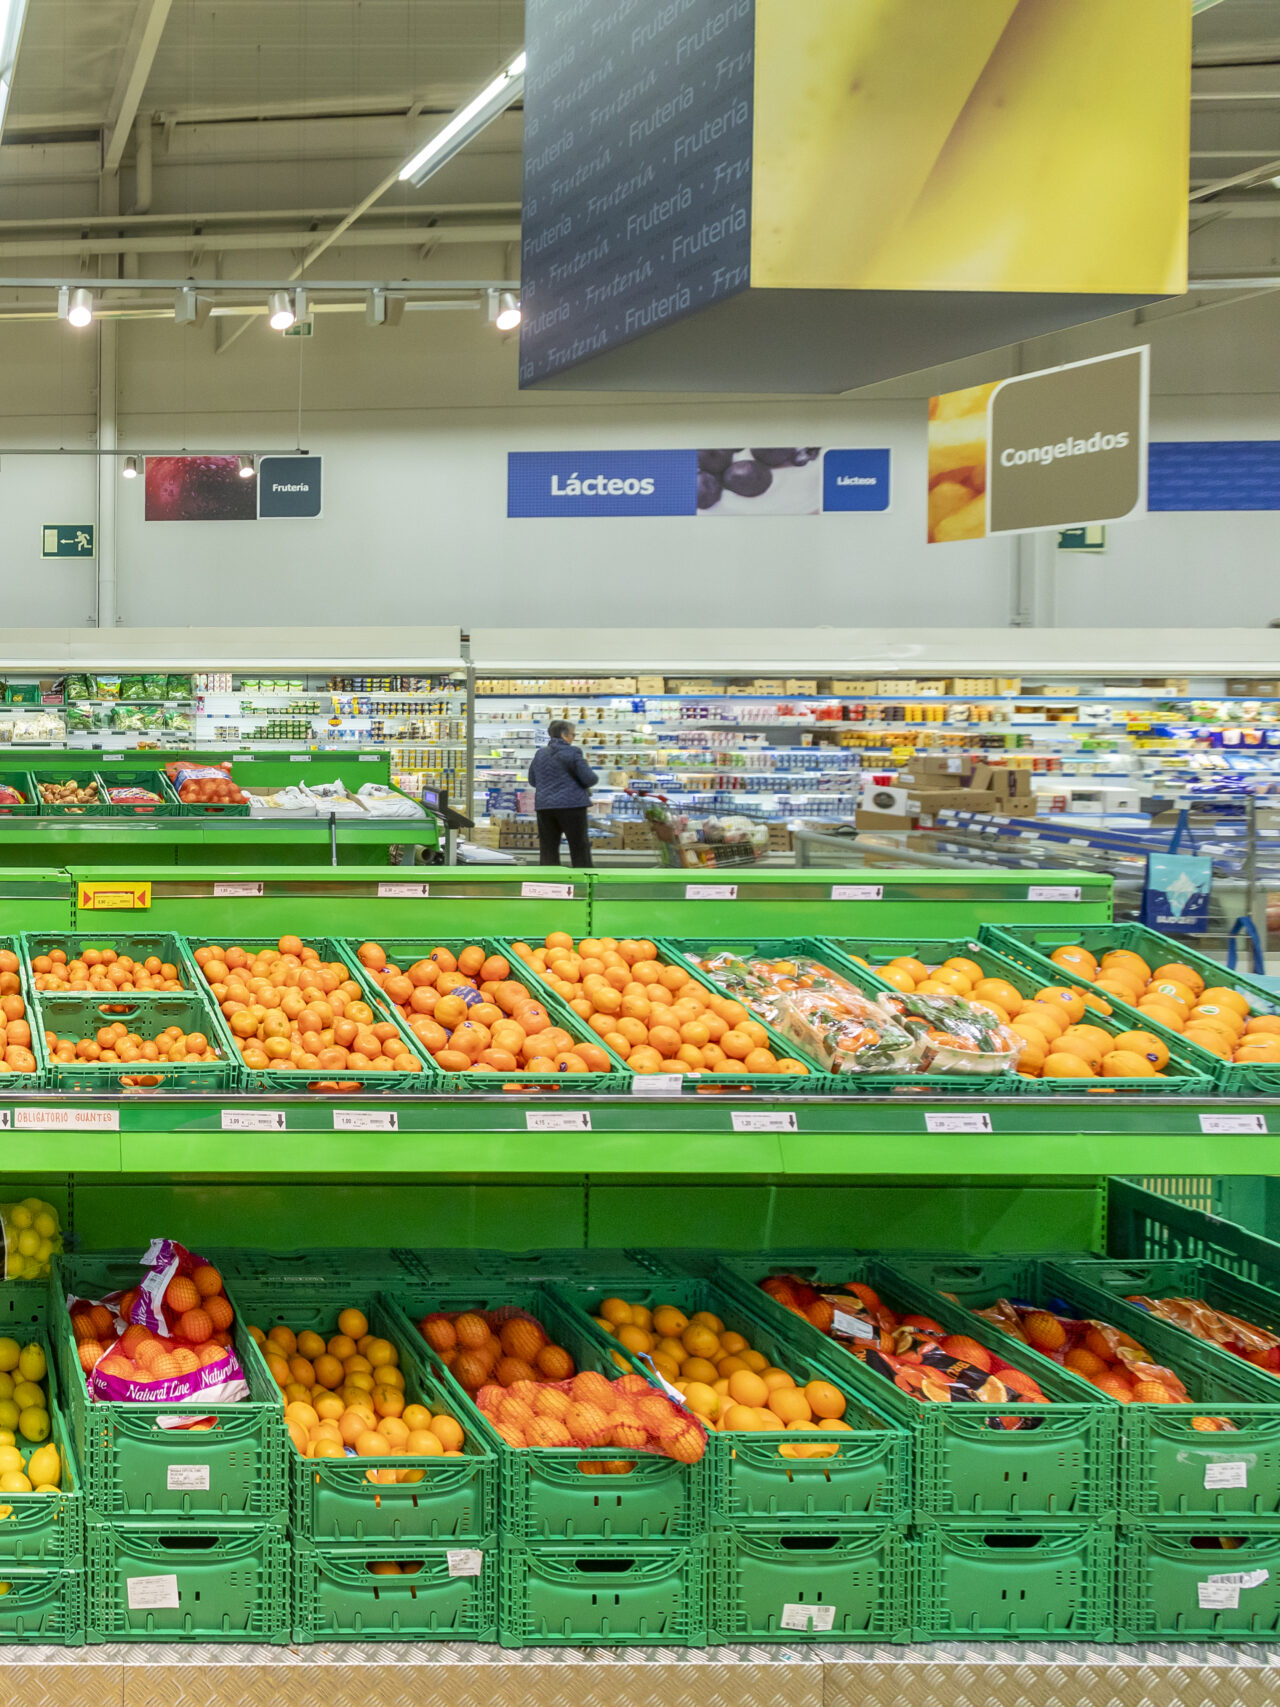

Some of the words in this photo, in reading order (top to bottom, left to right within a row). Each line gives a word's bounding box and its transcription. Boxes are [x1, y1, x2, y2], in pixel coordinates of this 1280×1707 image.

[629, 84, 694, 147] Frutería
[586, 160, 656, 224] Frutería
[674, 97, 748, 164] Frutería
[627, 184, 693, 241] Frutería
[584, 256, 654, 312] Frutería
[672, 203, 746, 264] Frutería
[625, 283, 690, 334] Frutería
[1000, 431, 1130, 468] Congelados
[272, 482, 309, 493] Frutería
[550, 472, 655, 496] Lácteos
[836, 475, 877, 486] Lácteos
[17, 1111, 69, 1123] OBLIGATORIO
[75, 1112, 112, 1122] GUANTES
[126, 1383, 168, 1401] Natural
[169, 1380, 191, 1397] Line
